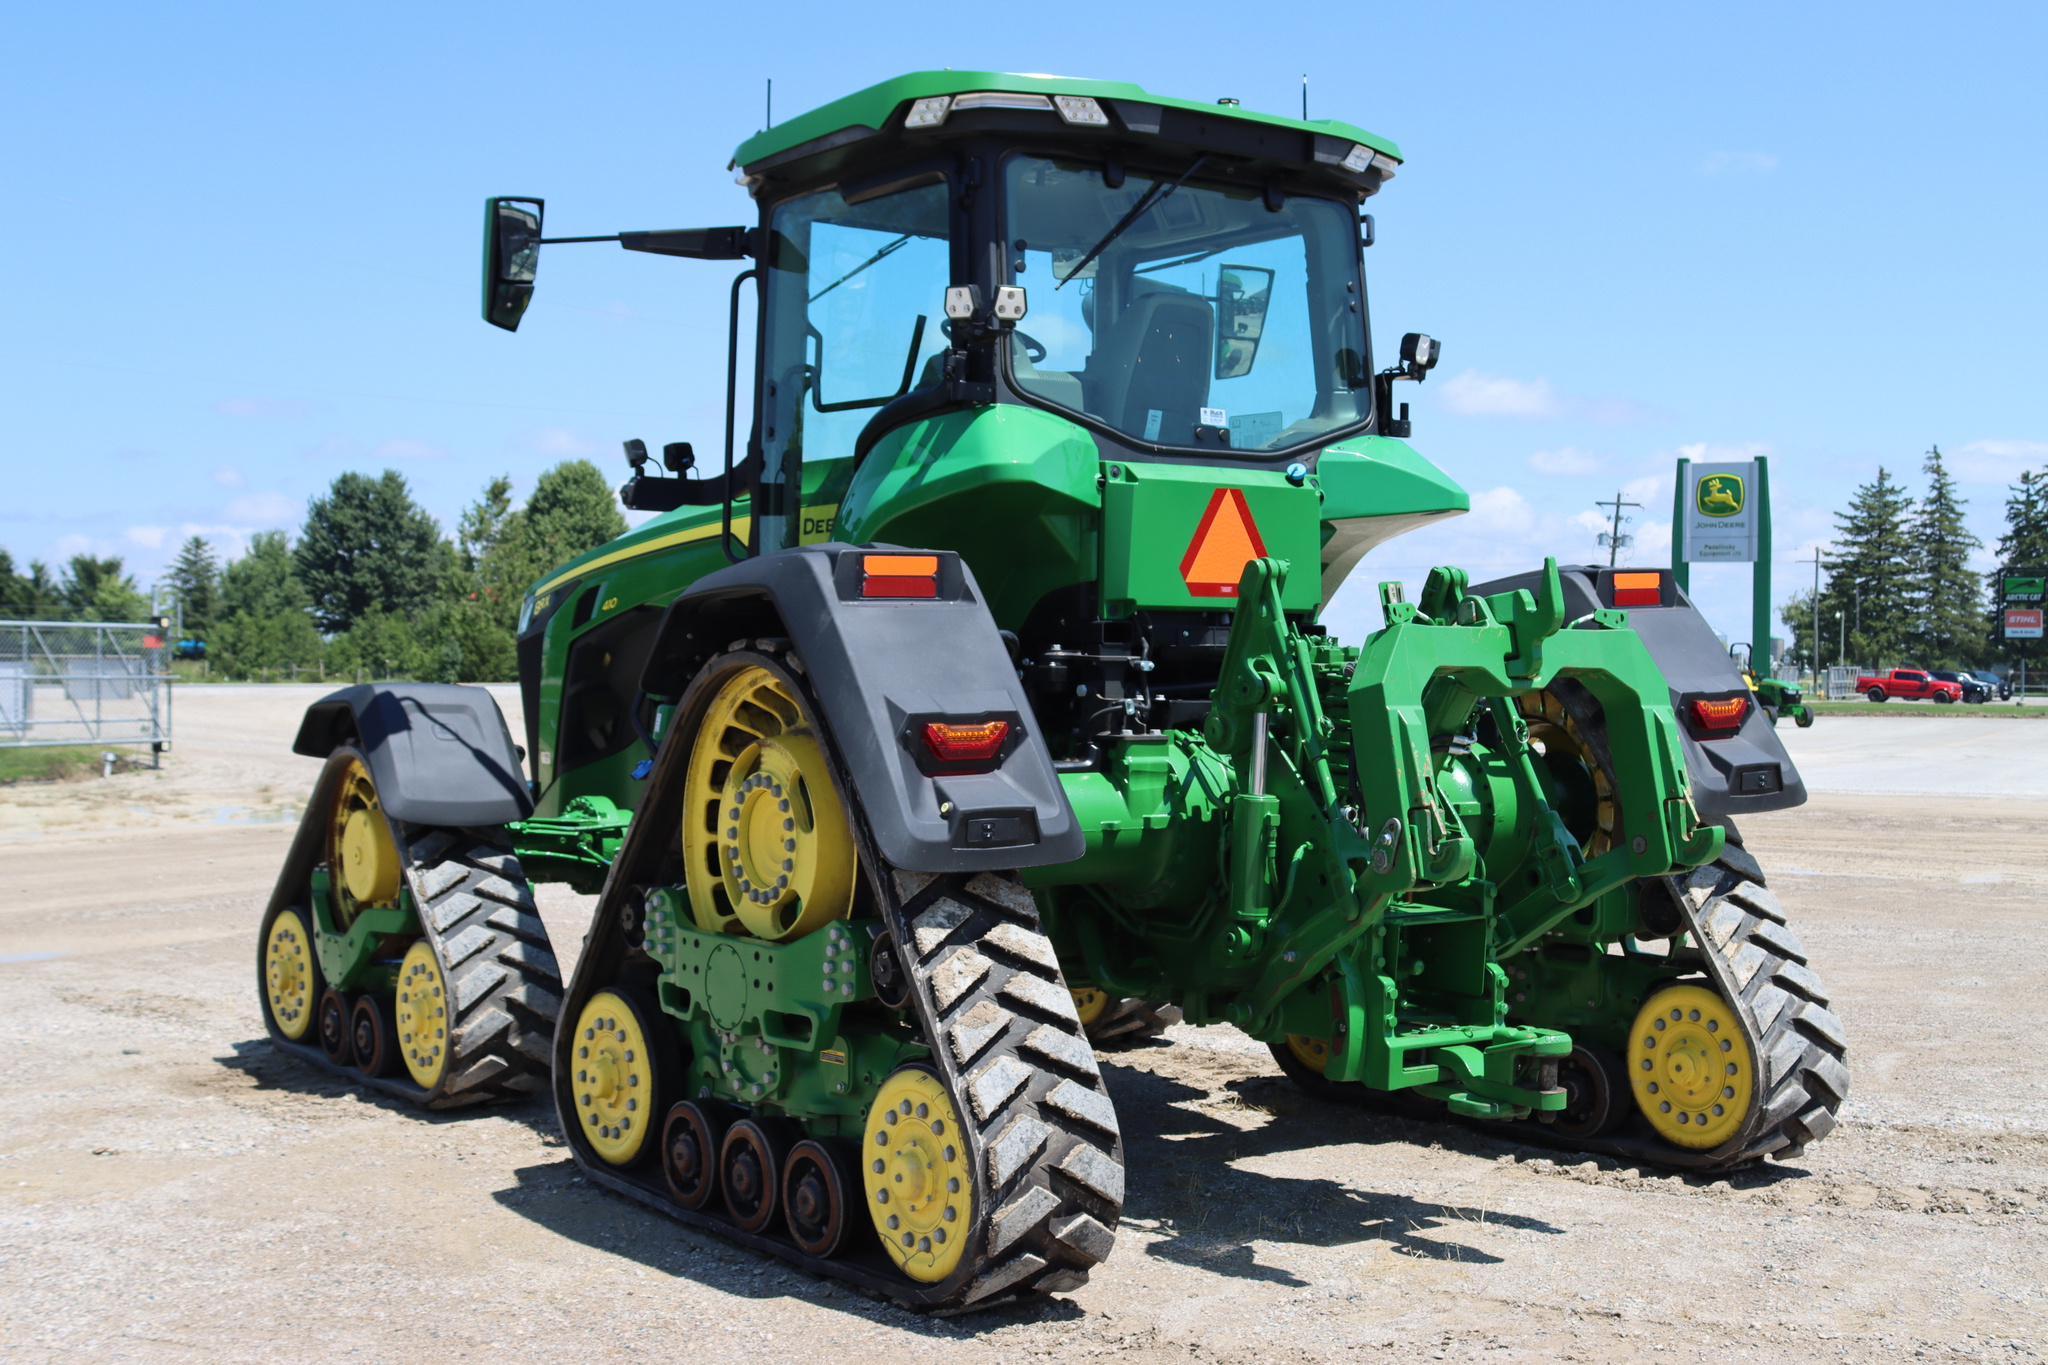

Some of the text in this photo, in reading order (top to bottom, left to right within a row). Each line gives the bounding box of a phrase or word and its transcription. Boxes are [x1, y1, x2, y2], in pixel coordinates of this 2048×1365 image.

[1695, 521, 1746, 529] JOHN DEERE
[2005, 593, 2042, 601] ARCTIC CAT
[601, 597, 618, 611] 410
[2009, 615, 2037, 623] STIHL
